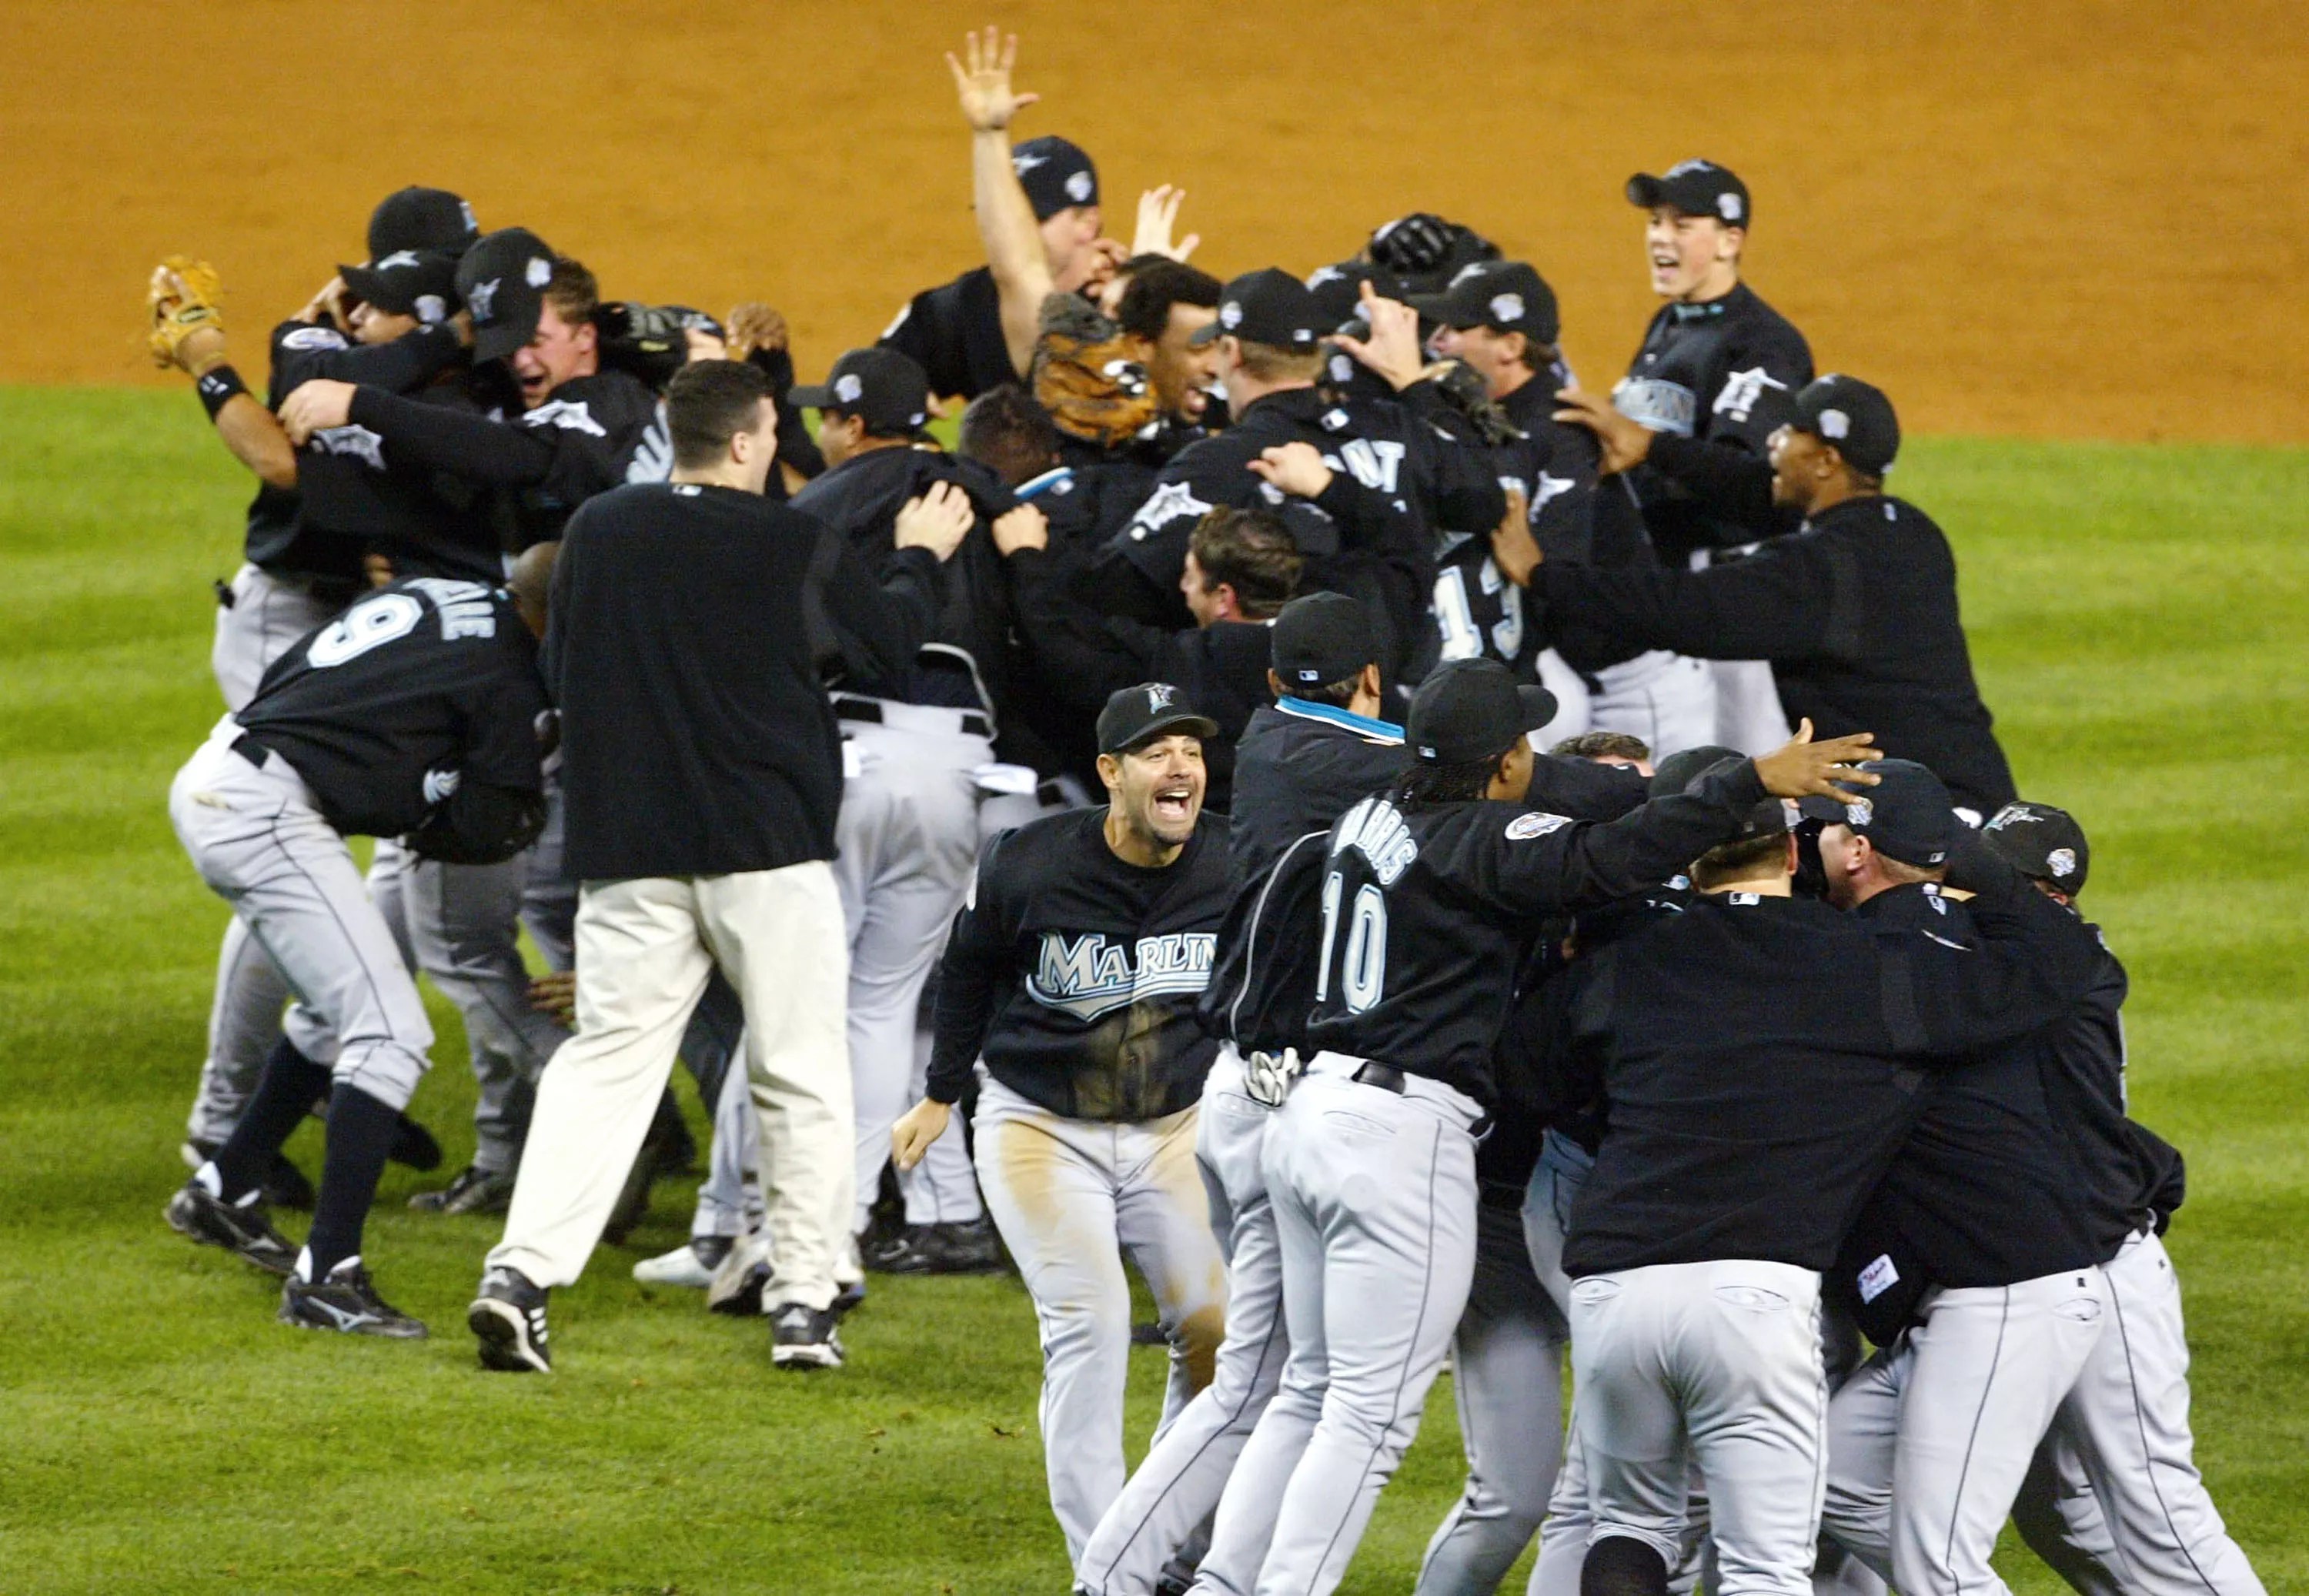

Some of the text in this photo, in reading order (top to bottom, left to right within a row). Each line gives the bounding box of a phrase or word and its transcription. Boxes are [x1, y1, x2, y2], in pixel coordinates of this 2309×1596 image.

[306, 593, 423, 668] 9
[1036, 932, 1218, 995] MARLIN
[1315, 871, 1388, 1014] 10
